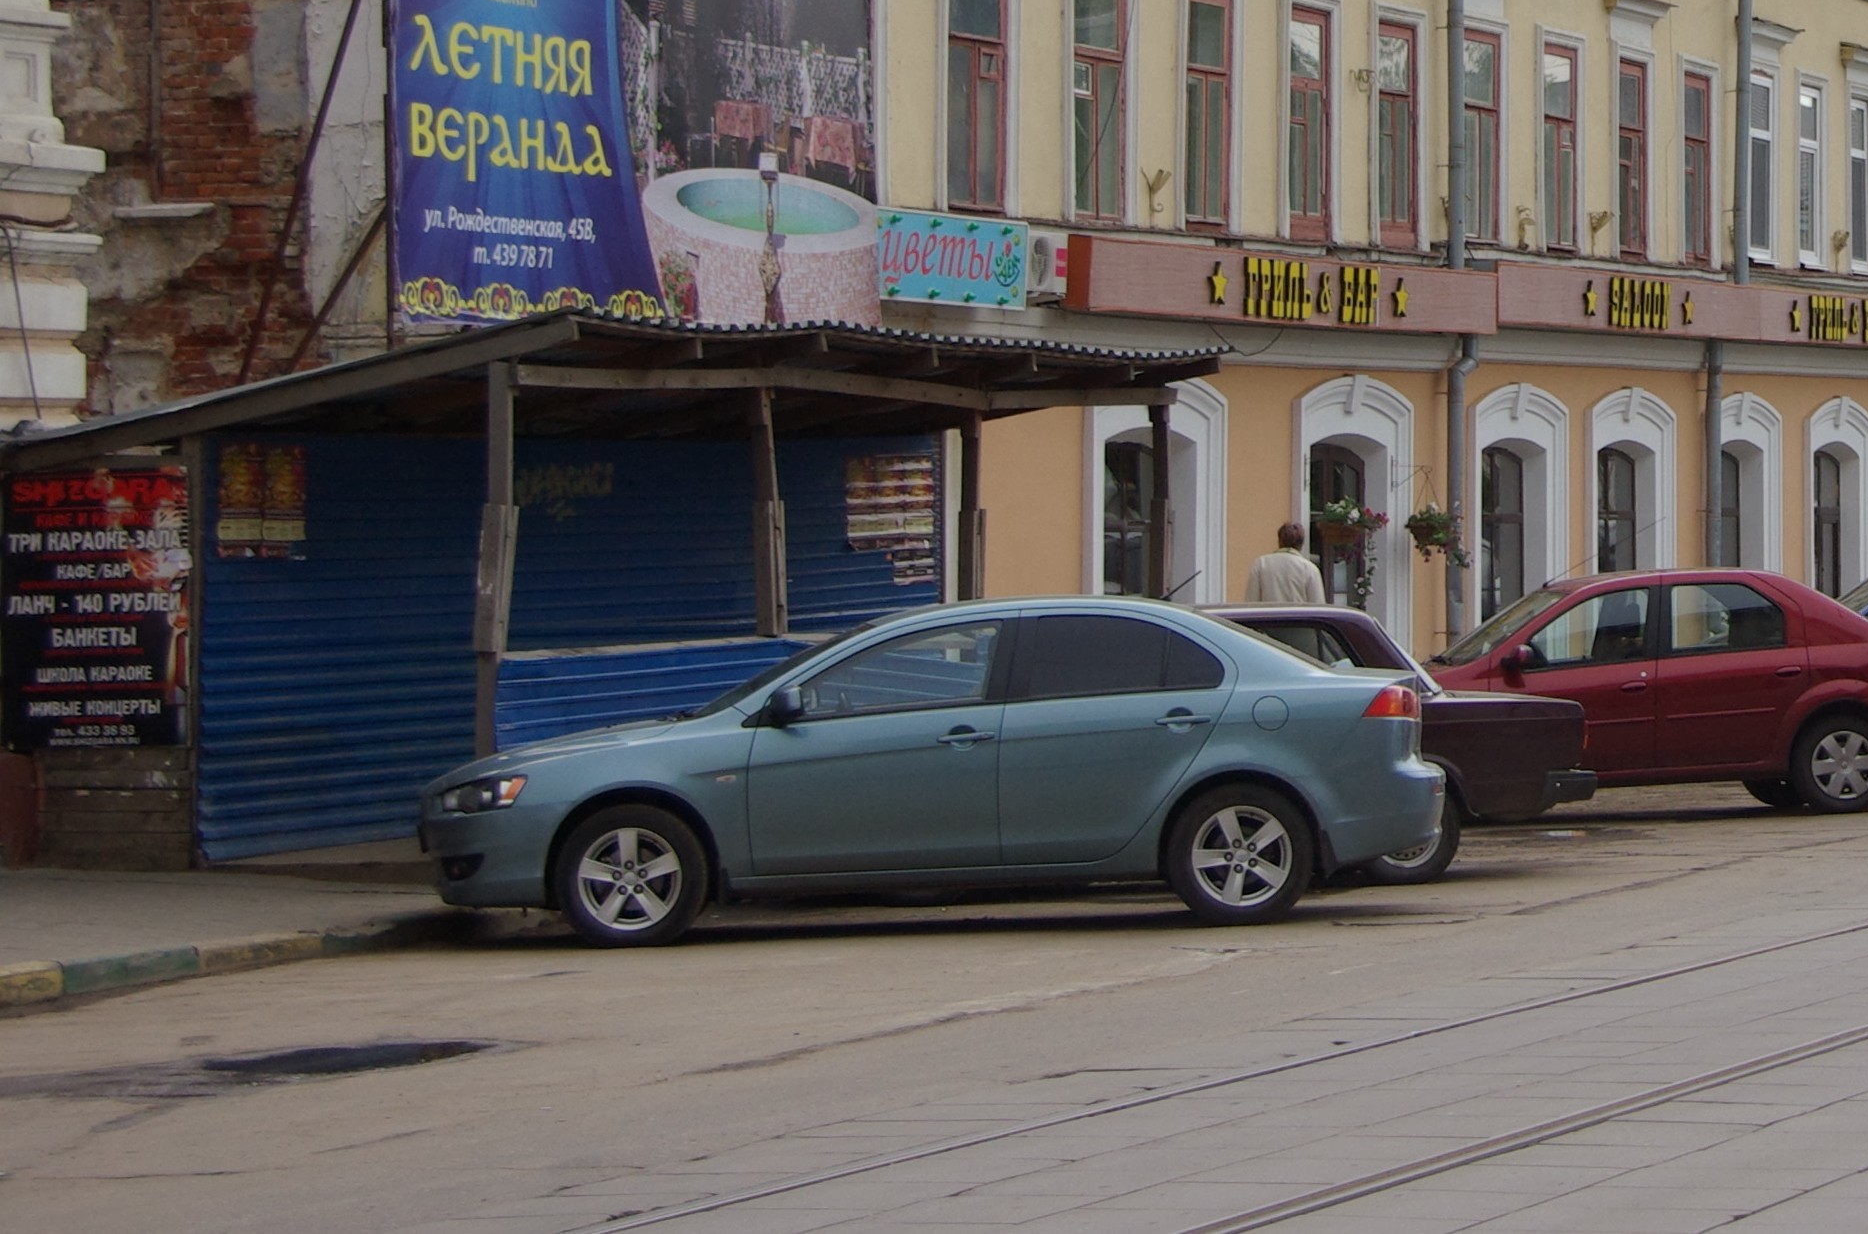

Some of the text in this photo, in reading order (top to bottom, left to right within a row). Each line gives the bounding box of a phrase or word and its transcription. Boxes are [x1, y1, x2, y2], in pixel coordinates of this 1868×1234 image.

[424, 207, 445, 233] ул.
[448, 205, 567, 242] Рождественская,
[493, 243, 519, 266] 439
[520, 245, 537, 267] 78
[537, 246, 554, 269] 71
[1243, 256, 1380, 324] ГРИЛЬ & БАР
[1608, 276, 1672, 330] SALOON
[1808, 295, 1848, 343] ГРИЛЬ
[8, 529, 181, 554] ТРИ КАРАОКЕ-ЗАЛА
[8, 595, 55, 616] ЛАНЧ
[75, 594, 103, 614] 140
[51, 627, 137, 648] БАНКЕТЫ
[36, 665, 153, 684] ШКОЛА КАРАОКЕ
[29, 698, 161, 718] ЖИВЫЕ КОНЦЕРТЫ
